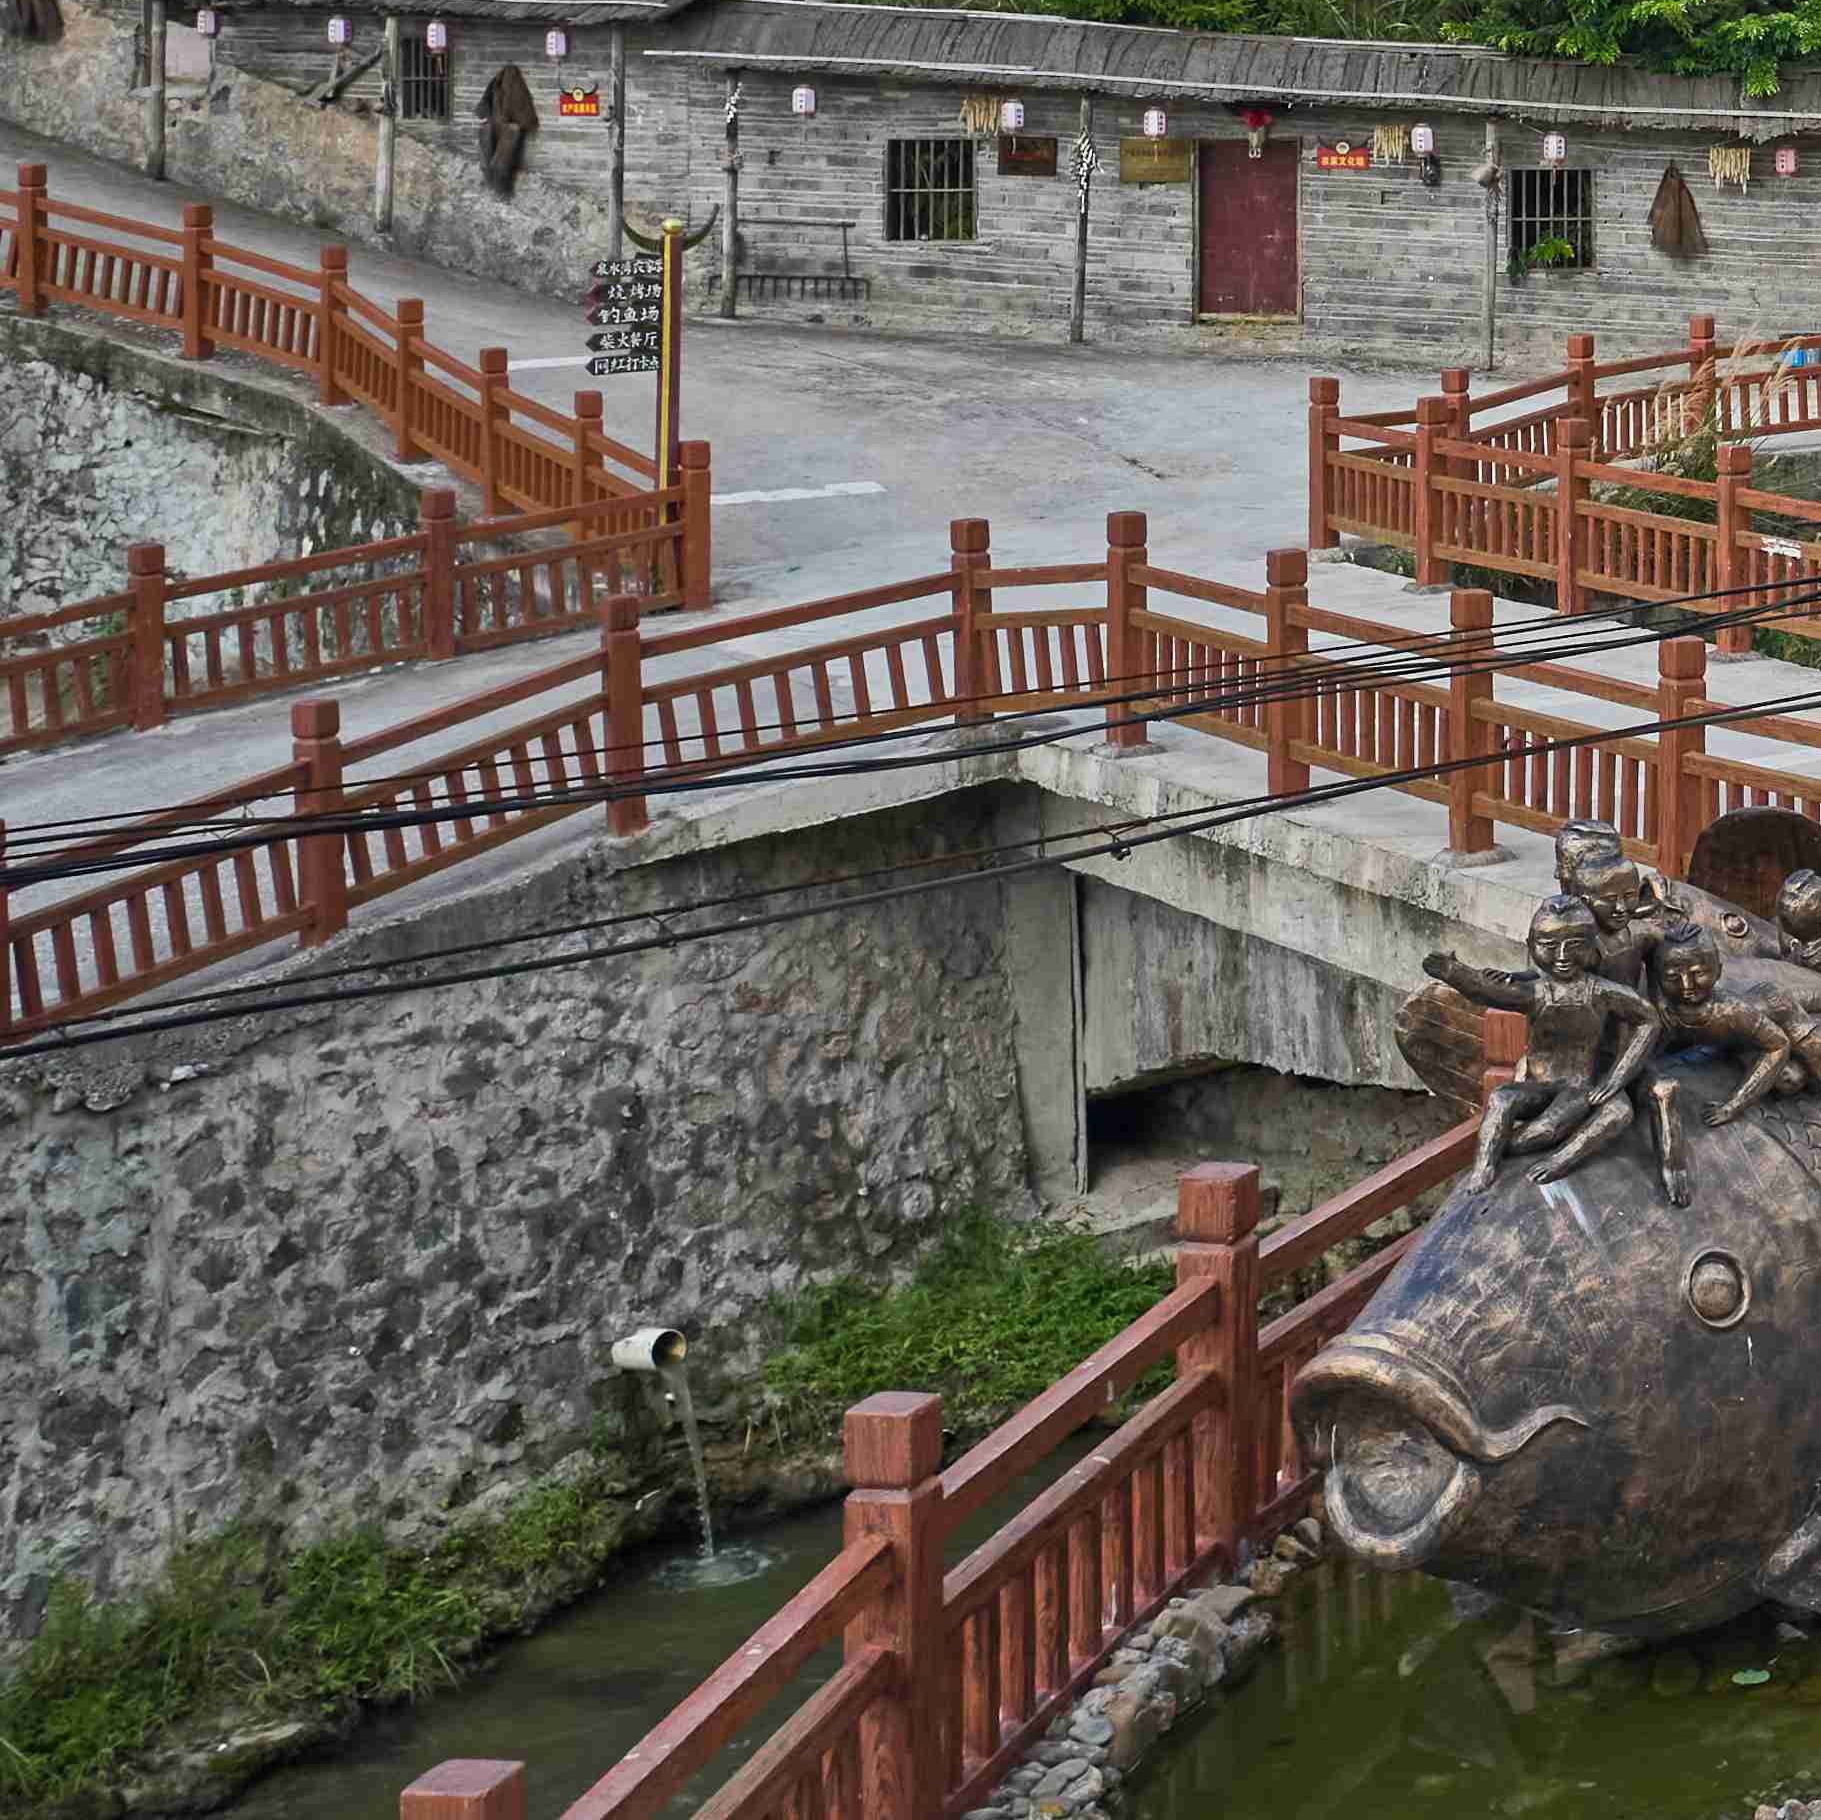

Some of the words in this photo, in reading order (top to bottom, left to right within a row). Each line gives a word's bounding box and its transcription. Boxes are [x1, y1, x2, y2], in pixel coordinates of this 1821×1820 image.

[598, 306, 660, 323] 钓鱼场
[600, 332, 658, 349] 柴火餐厅
[594, 355, 660, 374] 网红打卡点
